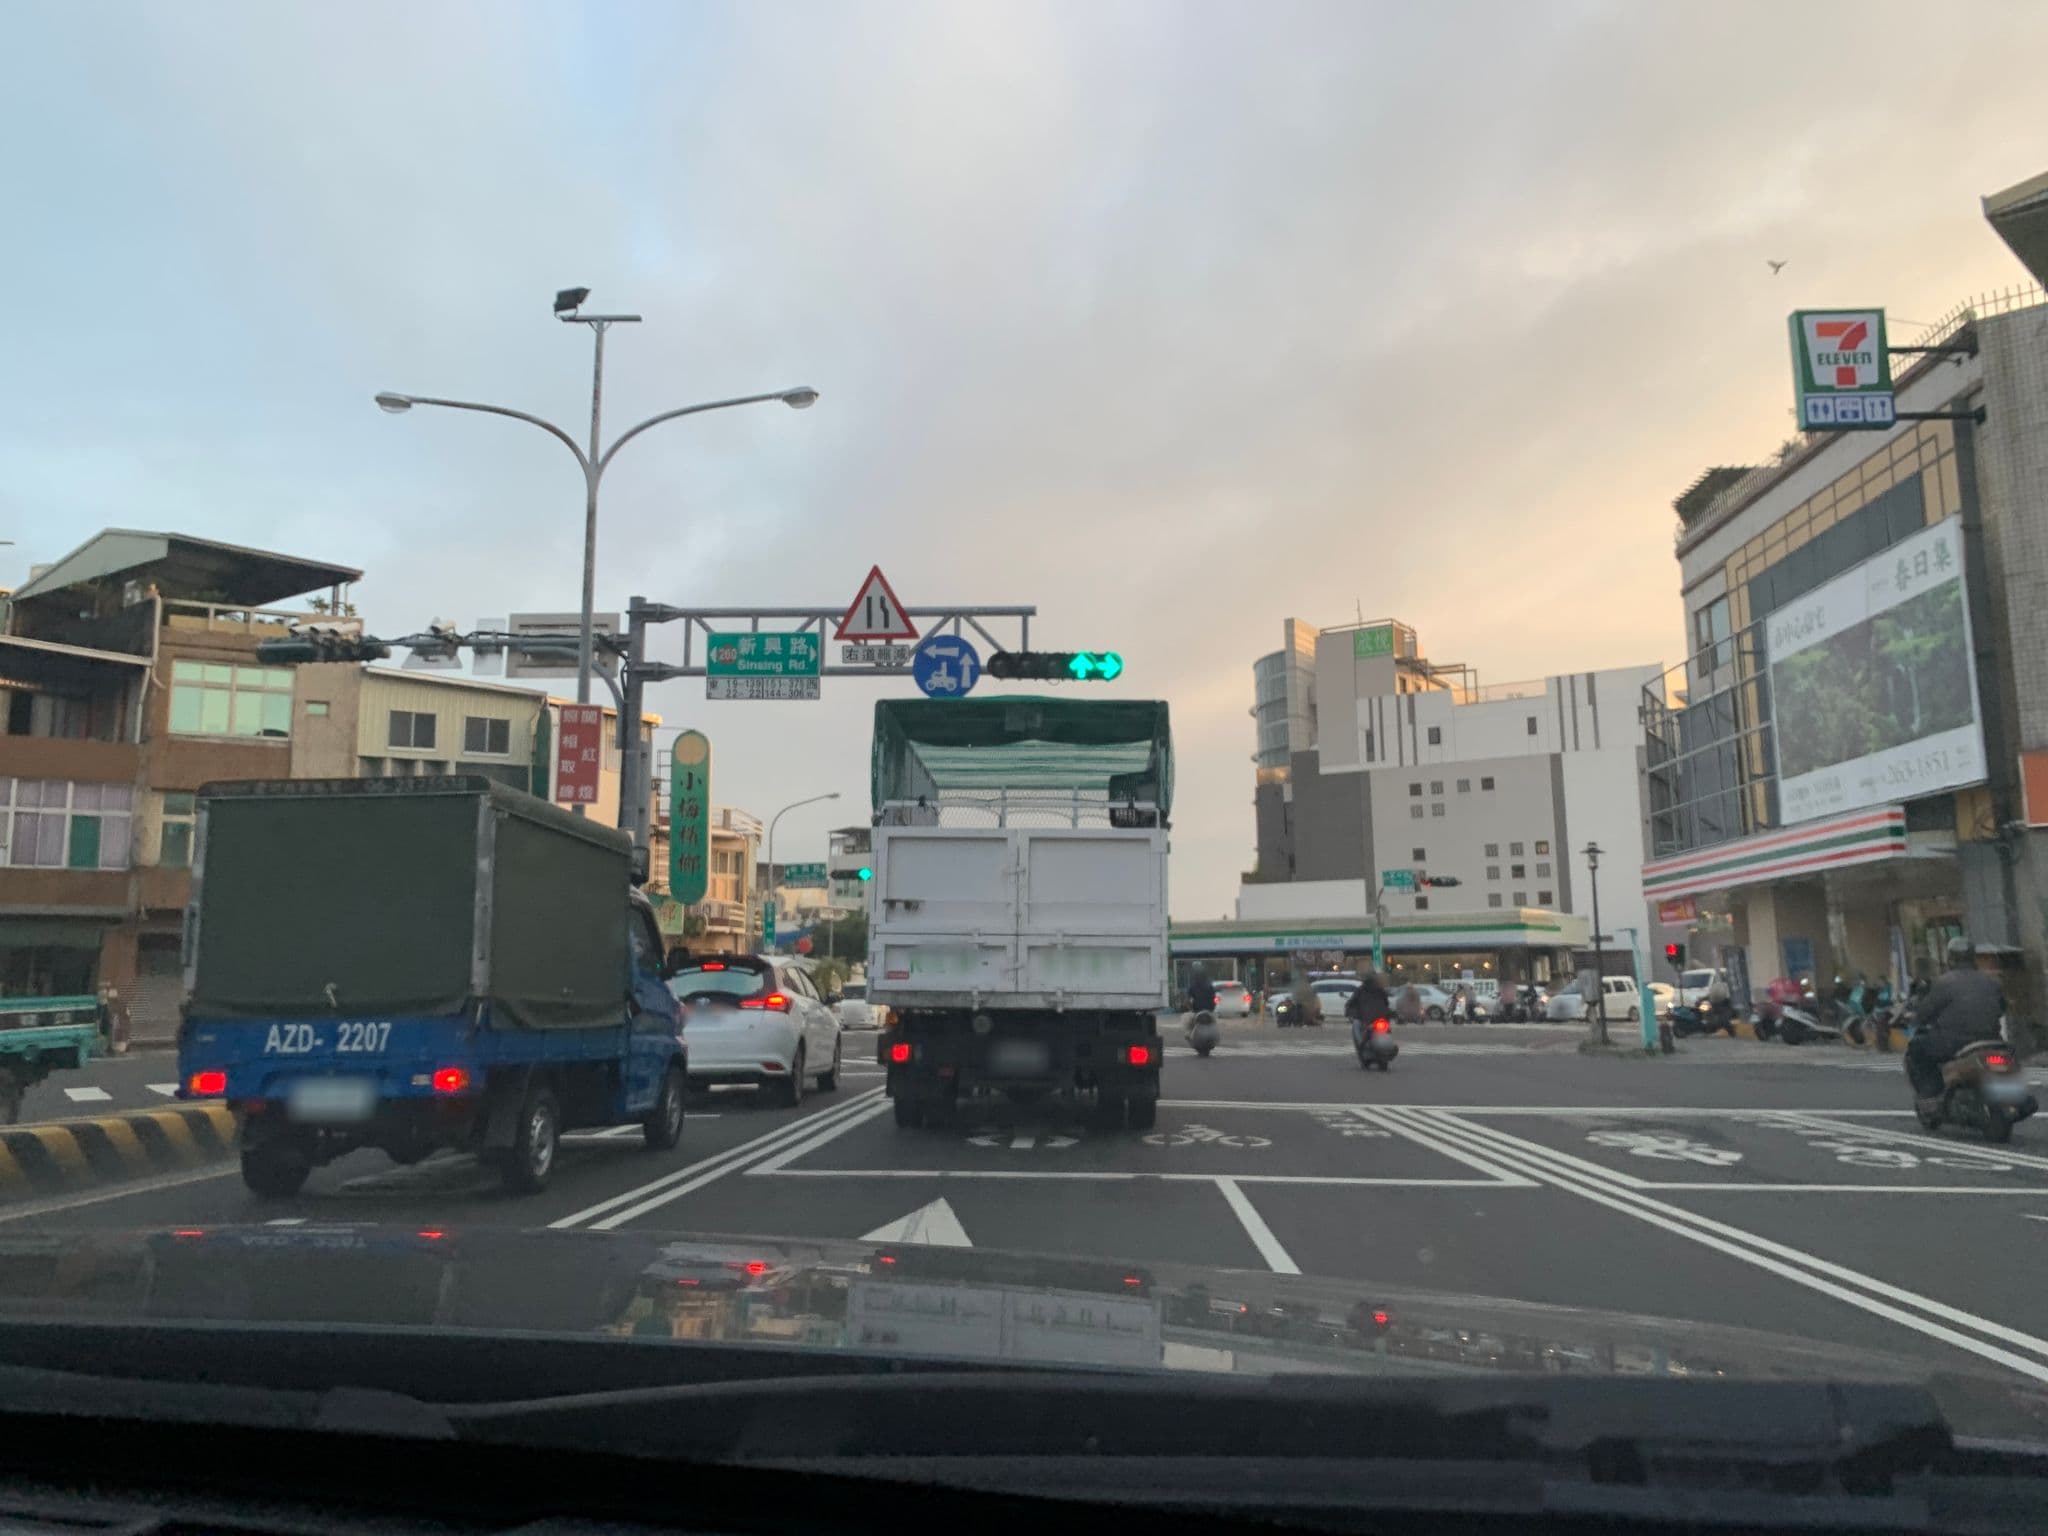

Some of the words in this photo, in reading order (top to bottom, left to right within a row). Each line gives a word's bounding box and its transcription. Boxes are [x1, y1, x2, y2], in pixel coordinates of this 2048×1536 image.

[738, 636, 808, 656] 新興路
[737, 659, 783, 672] Sinsing
[264, 1023, 323, 1053] AZD-
[336, 1022, 392, 1052] 2207
